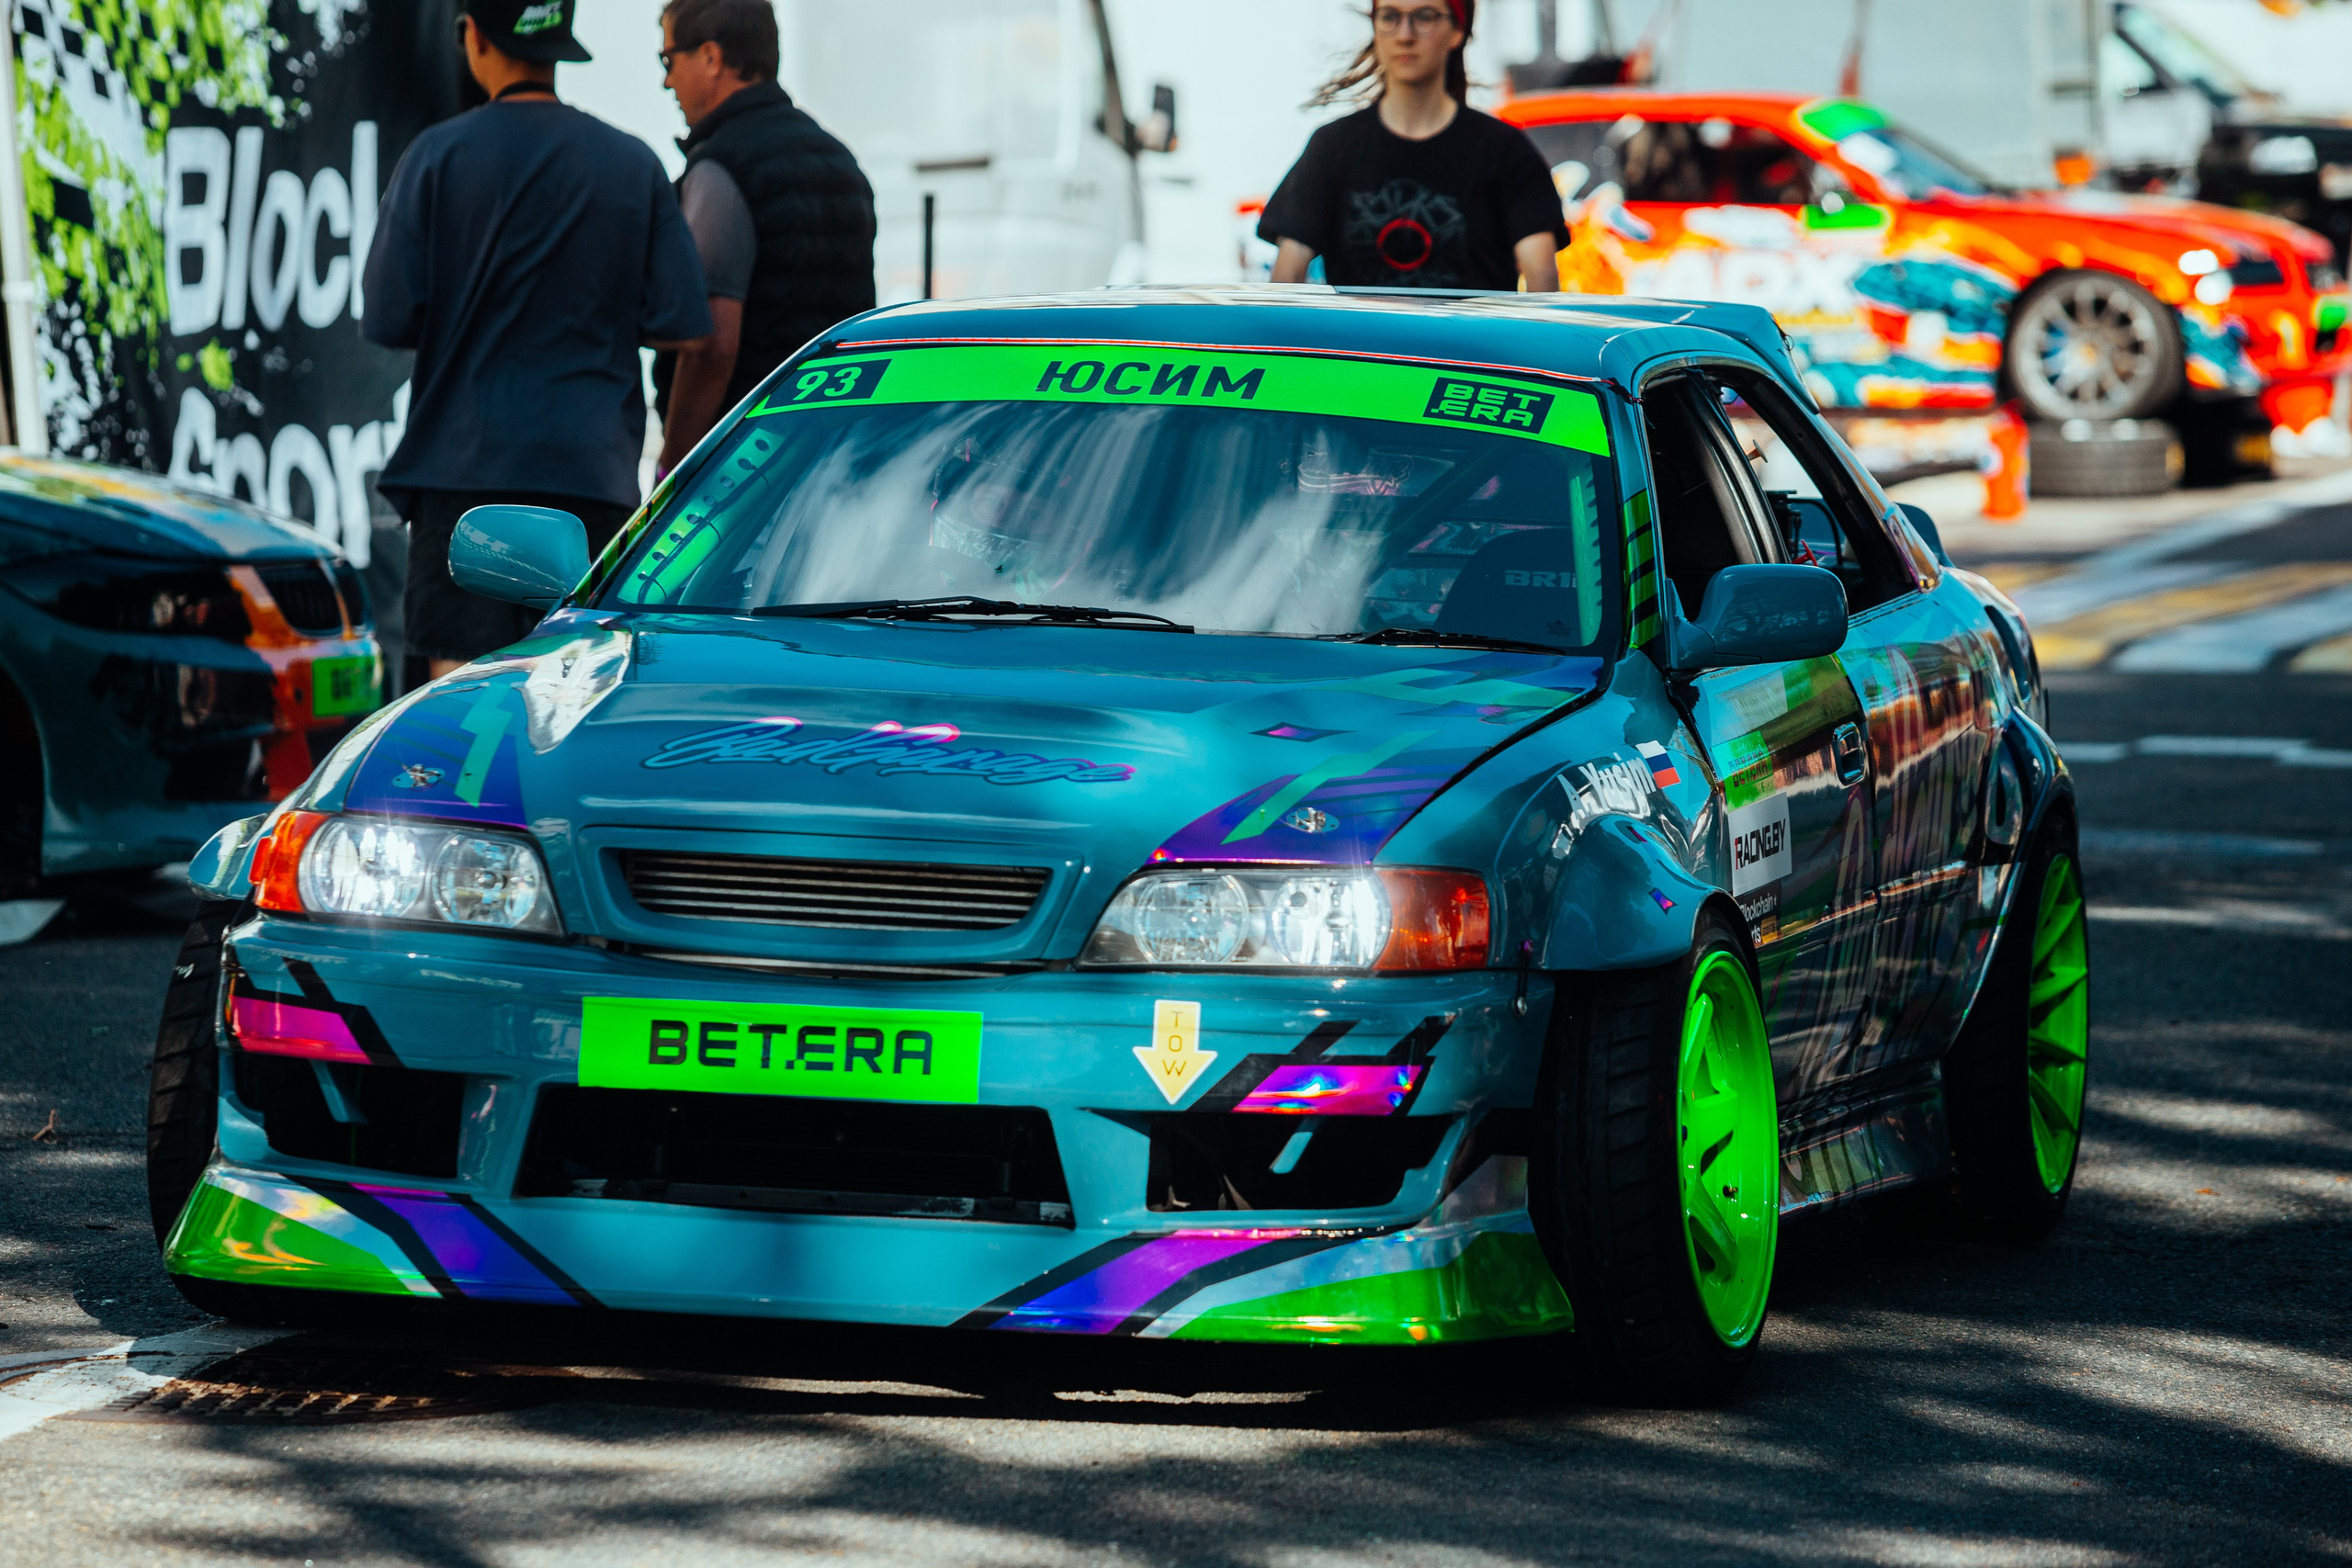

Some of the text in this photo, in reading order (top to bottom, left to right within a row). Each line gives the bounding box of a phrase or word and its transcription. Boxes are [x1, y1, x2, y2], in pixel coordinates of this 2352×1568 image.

[792, 367, 863, 400] 93
[1035, 360, 1267, 400] ЮСИМ
[1443, 383, 1541, 410] BET
[1504, 570, 1577, 588] BRI
[1161, 1010, 1188, 1077] TOW
